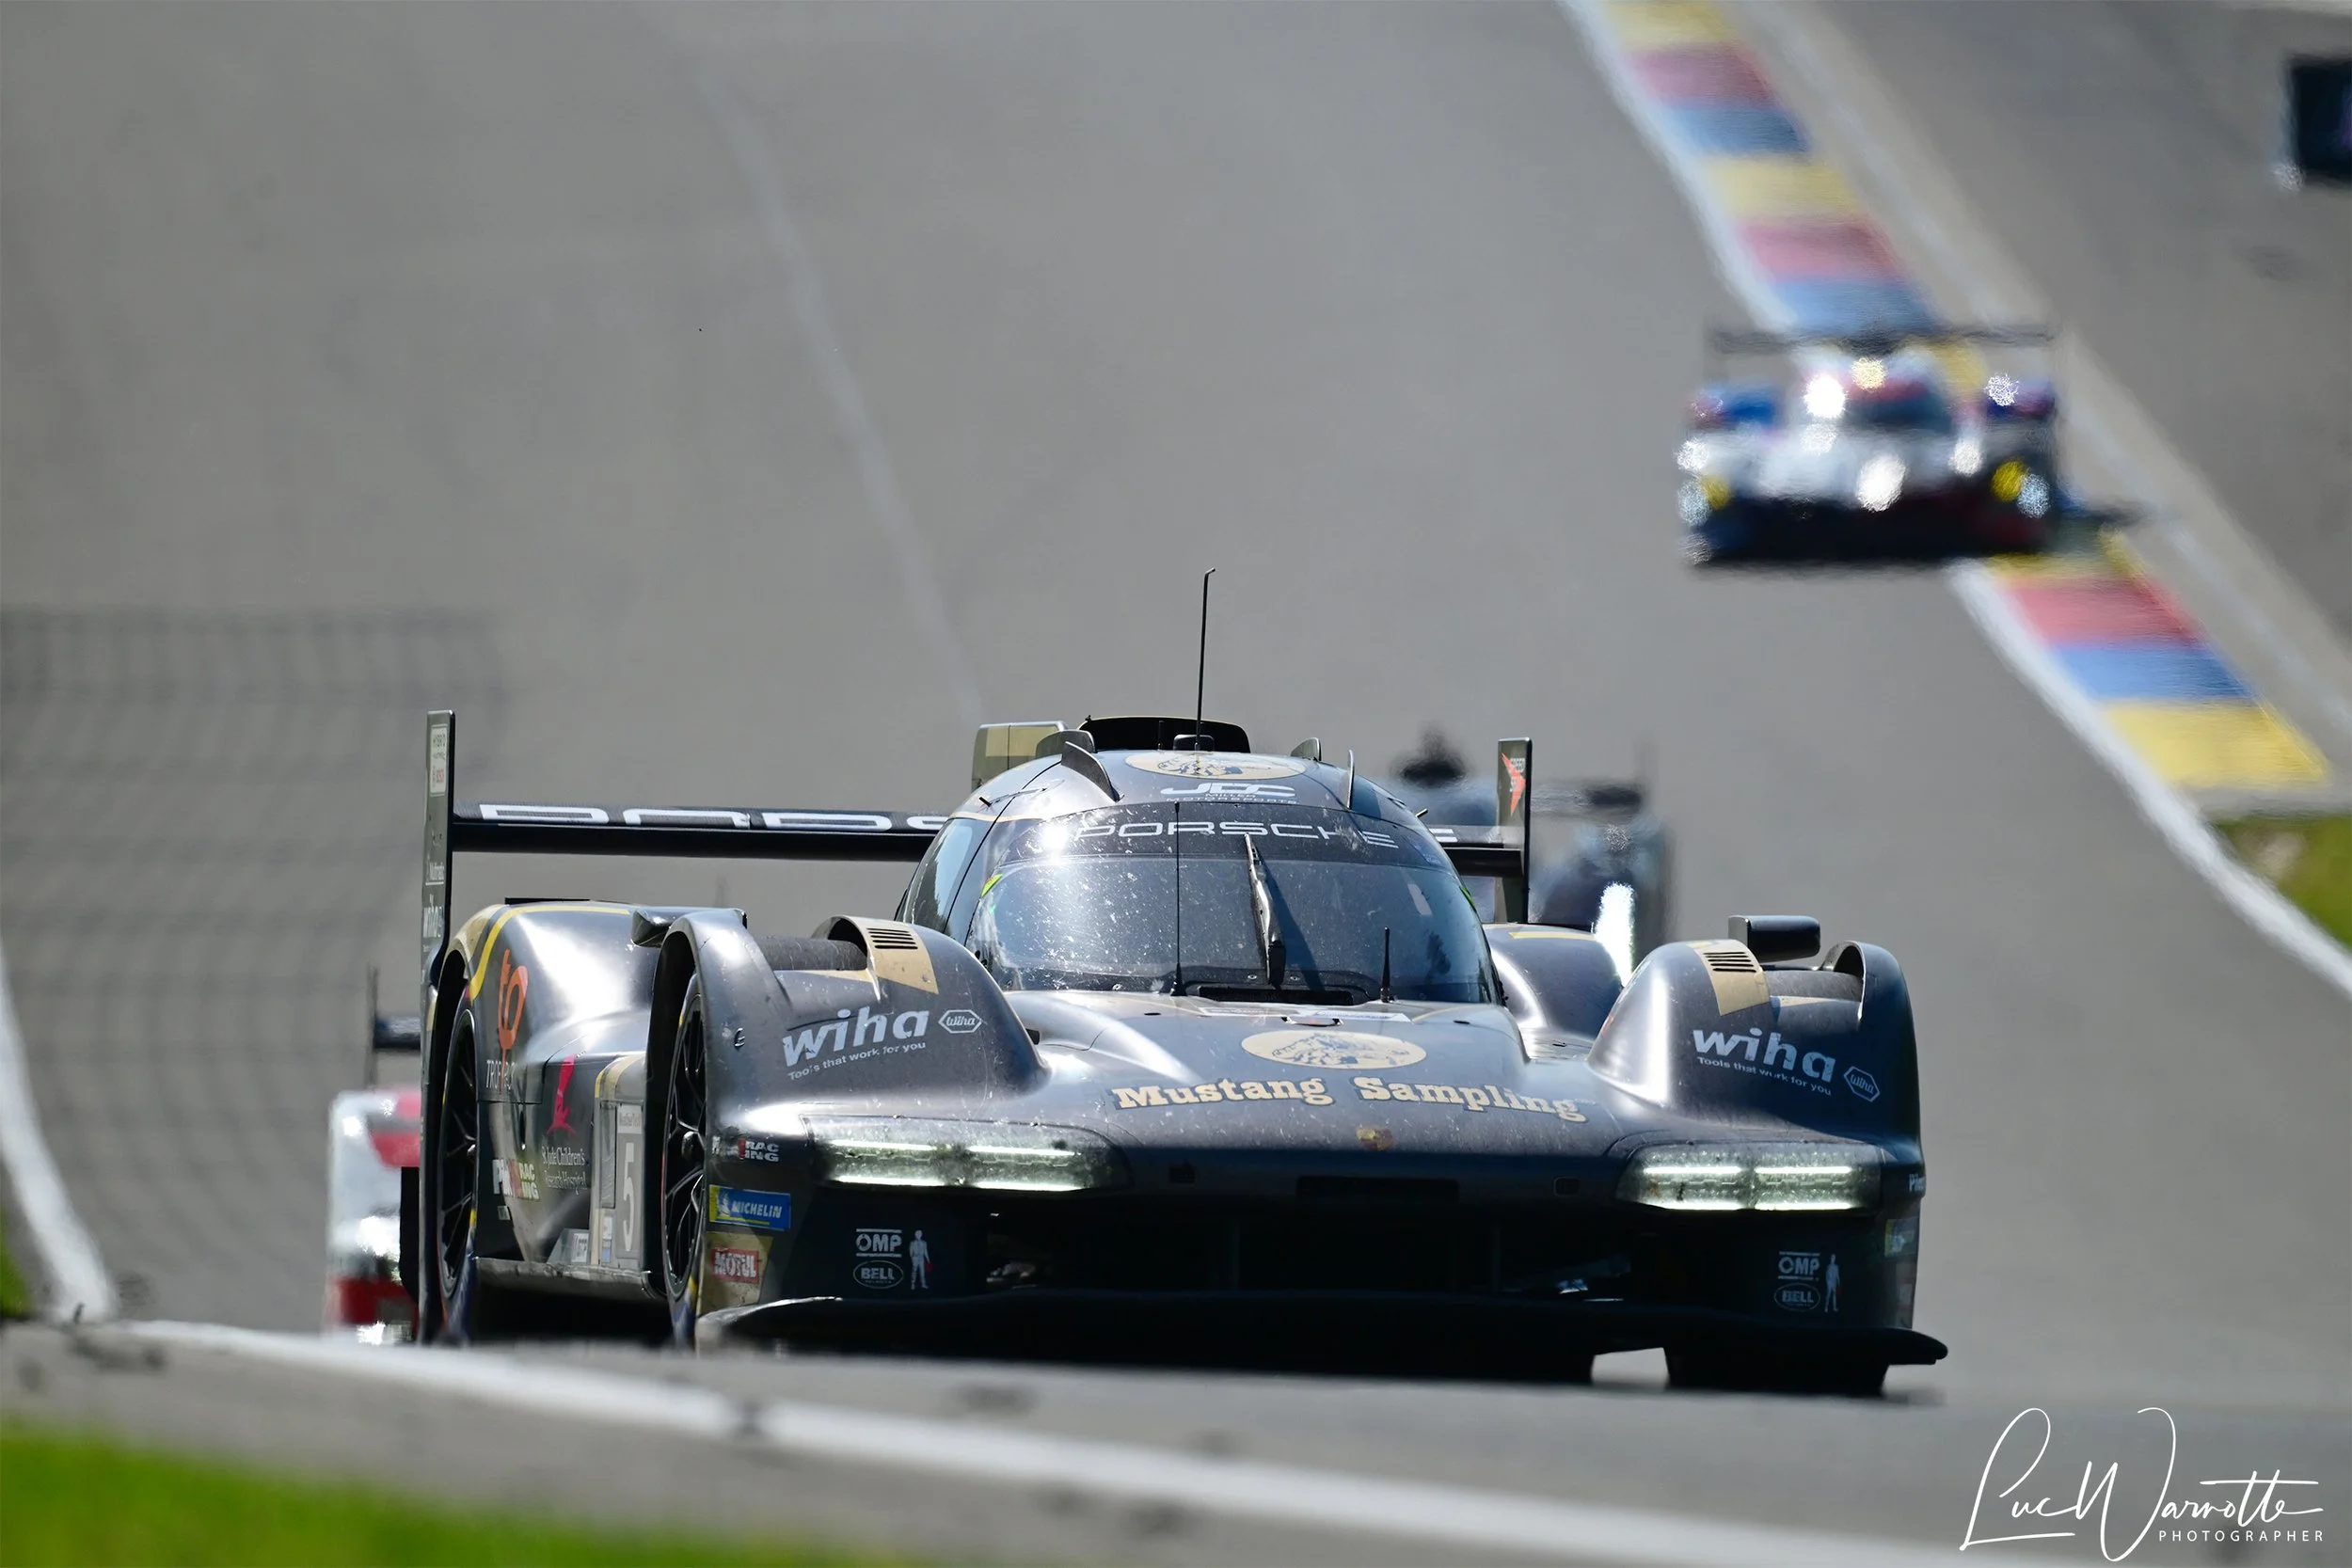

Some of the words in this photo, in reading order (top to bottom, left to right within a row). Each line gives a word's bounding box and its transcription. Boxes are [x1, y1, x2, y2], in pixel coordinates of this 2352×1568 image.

[1160, 783, 1295, 798] JDC
[782, 1006, 930, 1067] wiha
[822, 1055, 847, 1069] that
[849, 1048, 880, 1061] work
[882, 1045, 899, 1054] for
[902, 1041, 927, 1053] you
[1692, 1027, 1836, 1083] wiha
[1697, 1056, 1731, 1069] Tools
[1733, 1062, 1756, 1074] that
[1790, 1076, 1807, 1087] for
[1810, 1083, 1832, 1096] you
[1112, 1078, 1334, 1109] Mustang
[1353, 1075, 1588, 1123] Sampling
[623, 1142, 635, 1252] 5
[731, 1200, 783, 1219] MICHELIN
[856, 1233, 902, 1252] OMP
[714, 1251, 757, 1278] MOTUL
[861, 1267, 896, 1280] BELL
[1778, 1256, 1820, 1275] OMP
